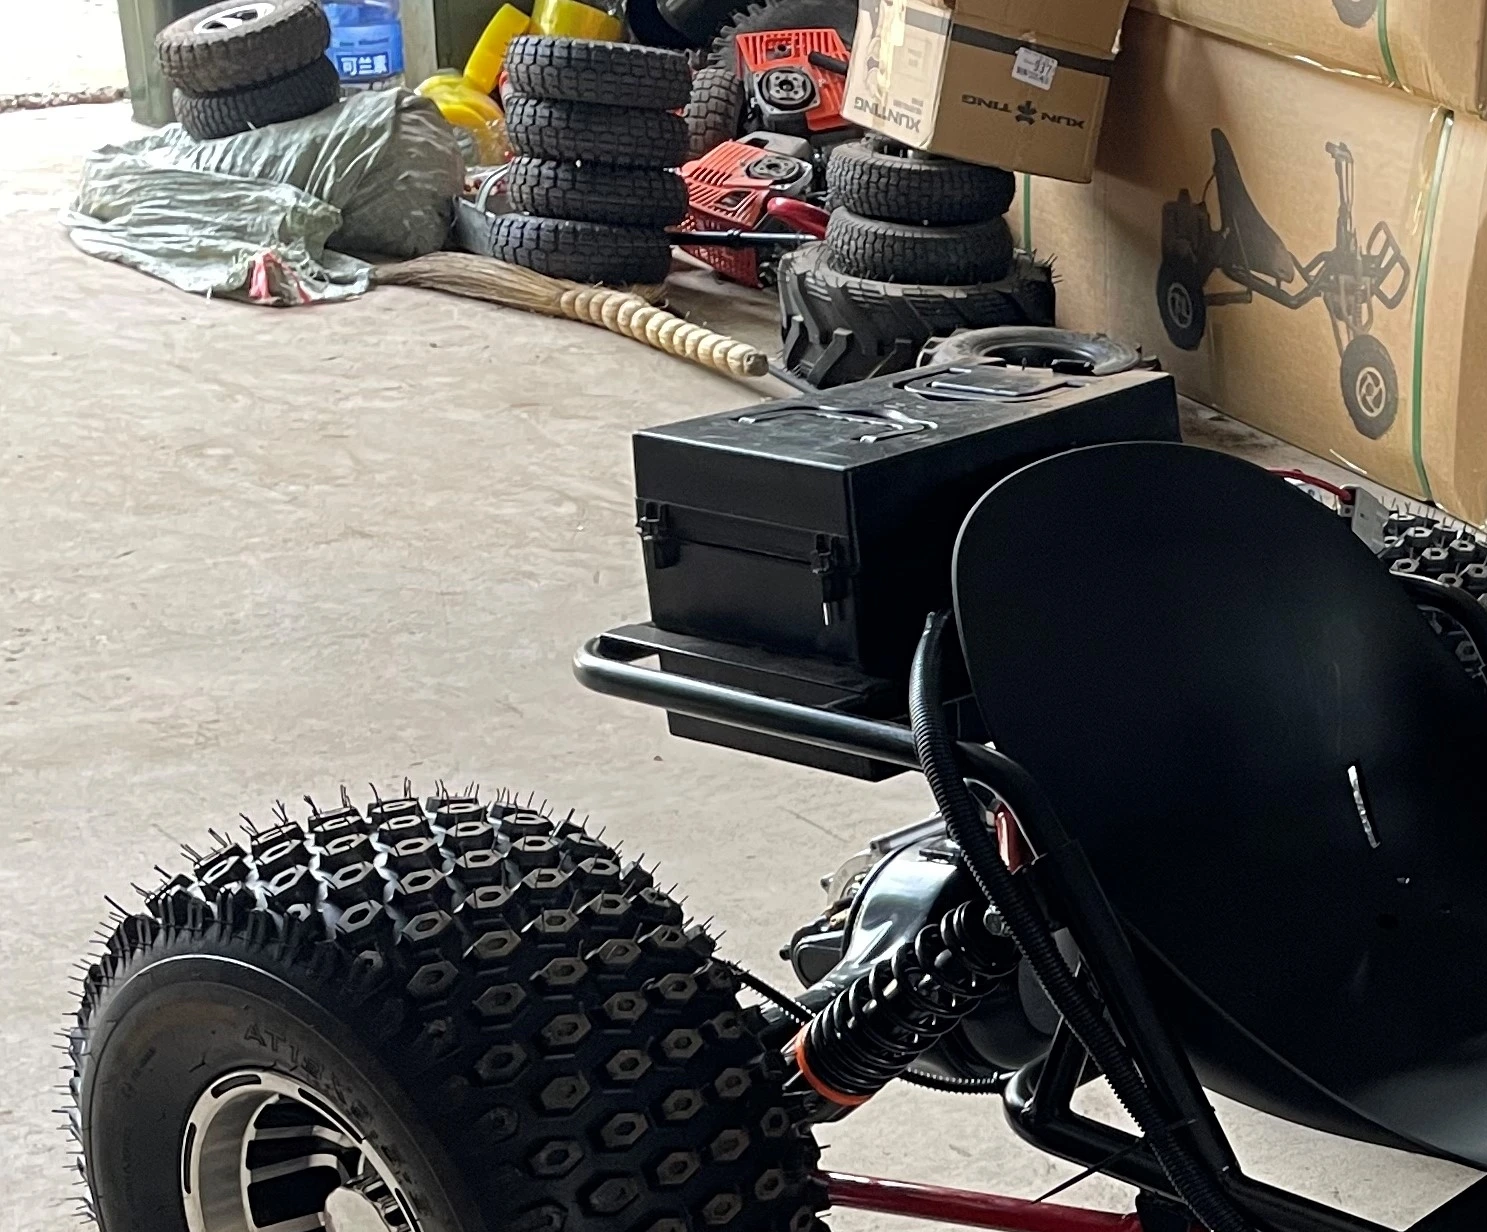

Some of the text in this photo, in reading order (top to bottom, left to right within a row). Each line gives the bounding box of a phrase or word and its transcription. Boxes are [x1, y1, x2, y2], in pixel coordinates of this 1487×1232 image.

[853, 96, 922, 133] XUNTING
[961, 93, 1085, 129] XUN TING
